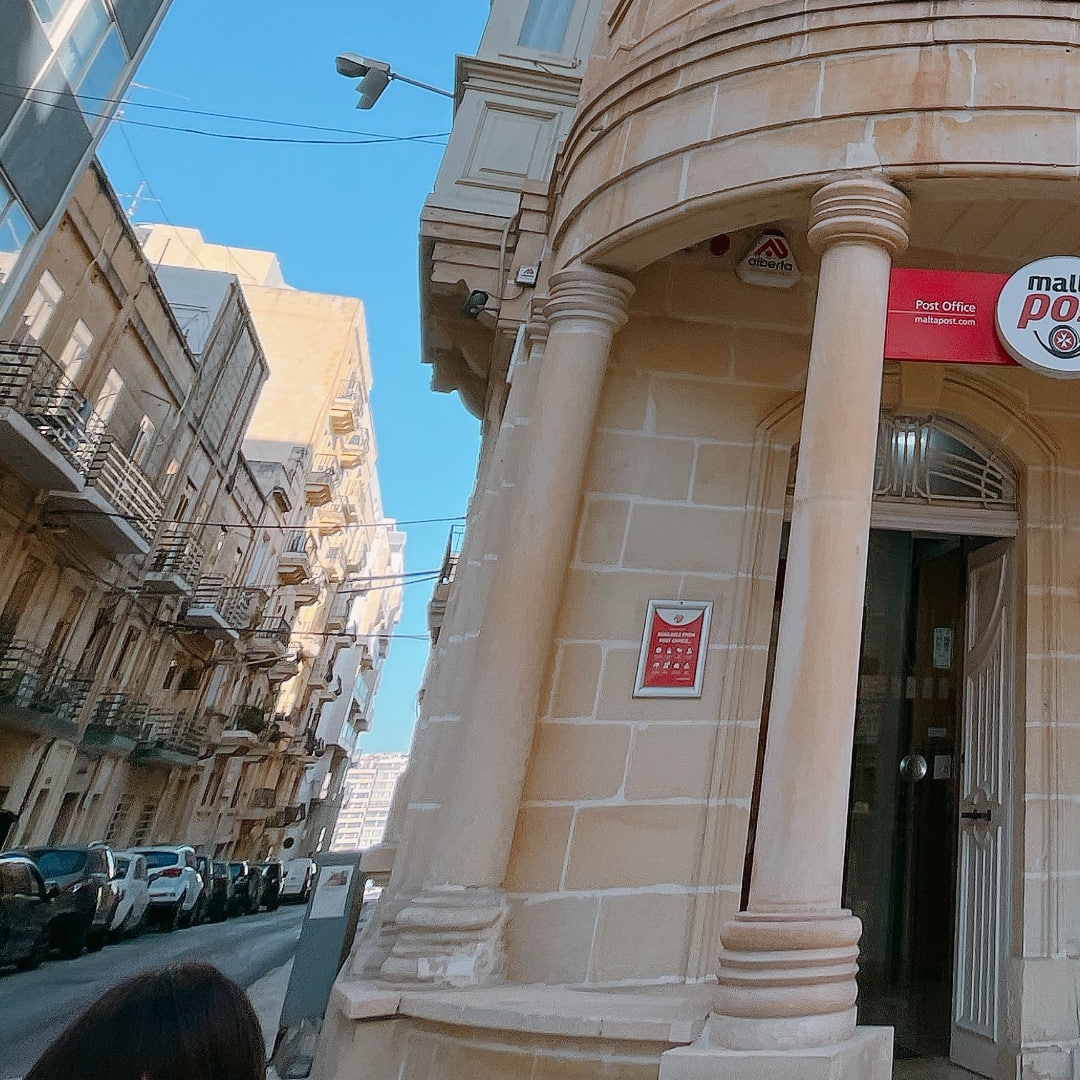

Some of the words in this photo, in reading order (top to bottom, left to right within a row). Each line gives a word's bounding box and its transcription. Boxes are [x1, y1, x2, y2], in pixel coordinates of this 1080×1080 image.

[748, 256, 793, 271] alberta
[915, 299, 940, 311] Post
[942, 300, 976, 313] Office
[914, 315, 976, 326] maltapost.com
